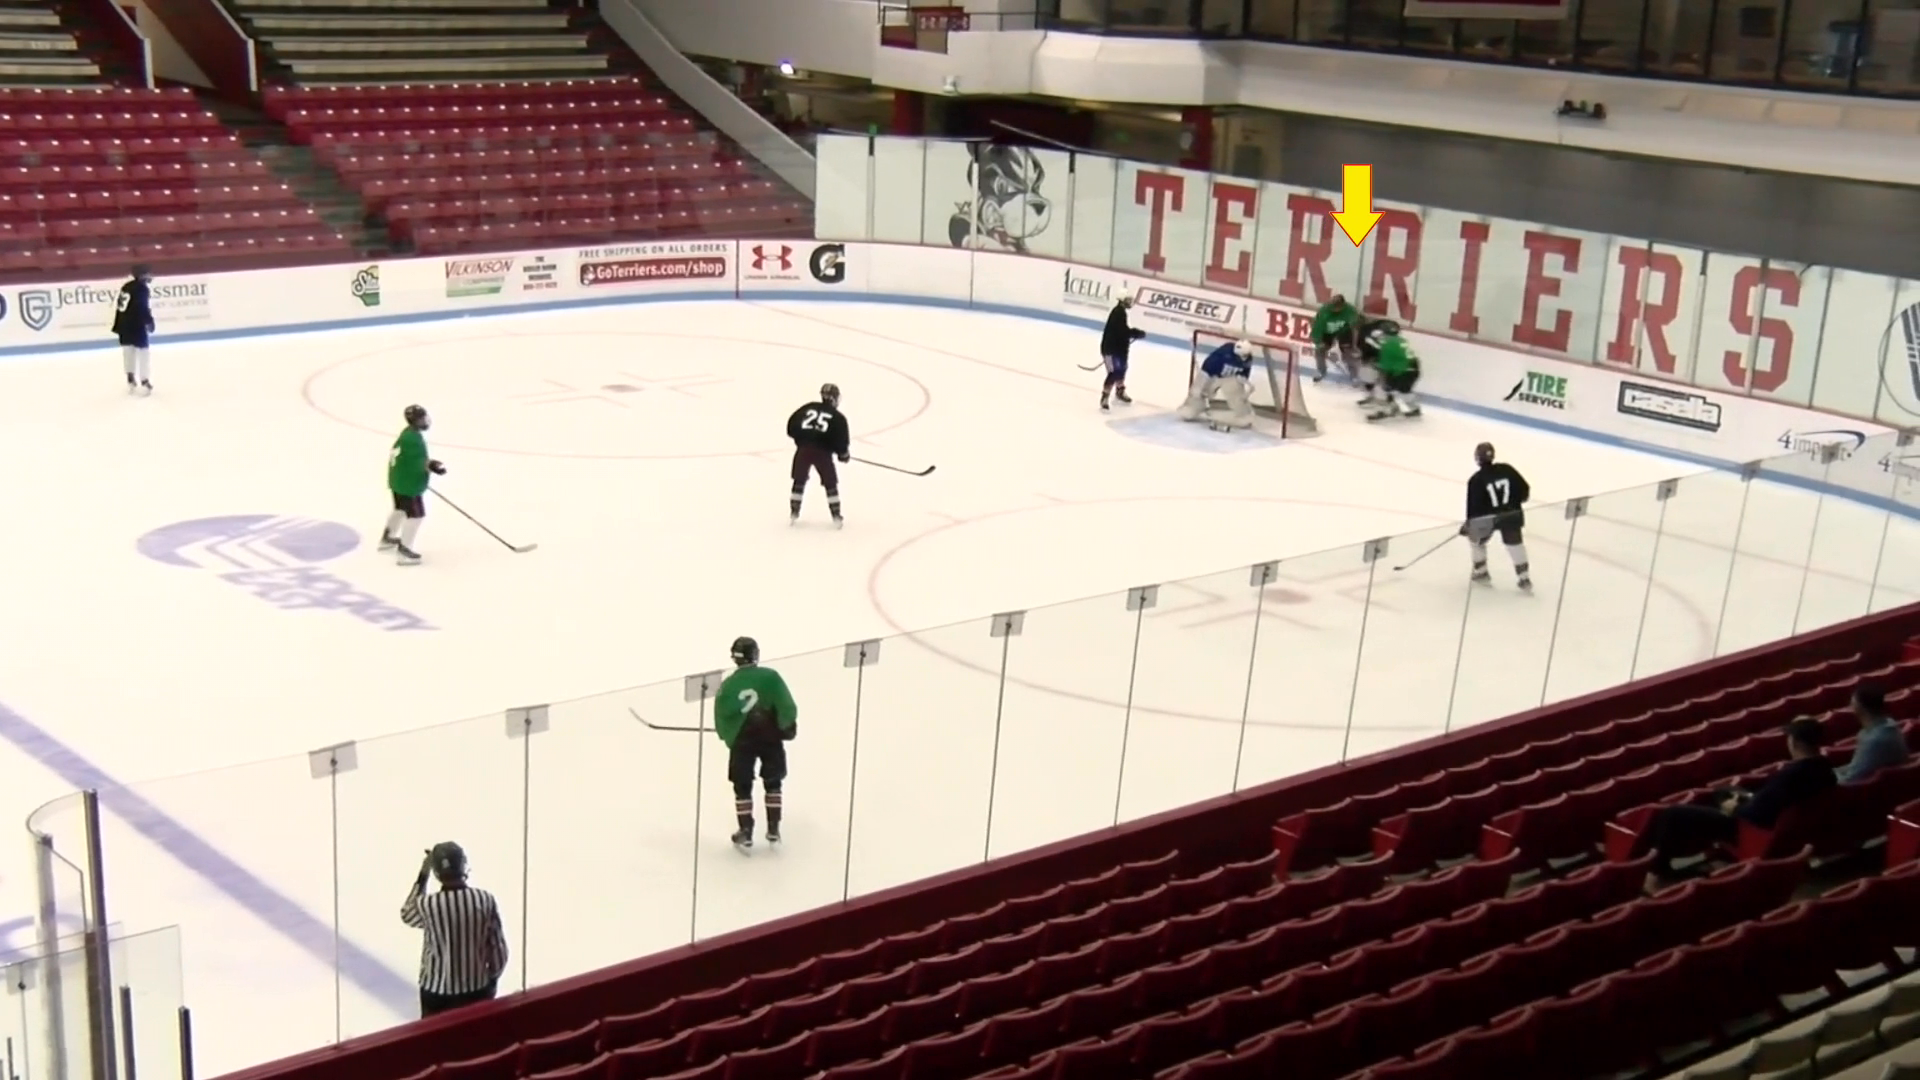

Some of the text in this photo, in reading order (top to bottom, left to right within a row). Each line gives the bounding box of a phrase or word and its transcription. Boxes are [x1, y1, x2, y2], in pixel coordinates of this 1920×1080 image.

[579, 244, 727, 258] FREE SHIPPING ON ALL ORDERS
[596, 260, 723, 279] GoTerriers.com/shop
[1135, 170, 1800, 392] TERRIERS
[55, 285, 118, 309] Jeffrey
[1148, 293, 1193, 311] SPORTS
[1527, 371, 1568, 398] TIRE
[1518, 392, 1566, 410] SERVICE
[802, 409, 833, 432] 25
[1486, 478, 1510, 507] 17
